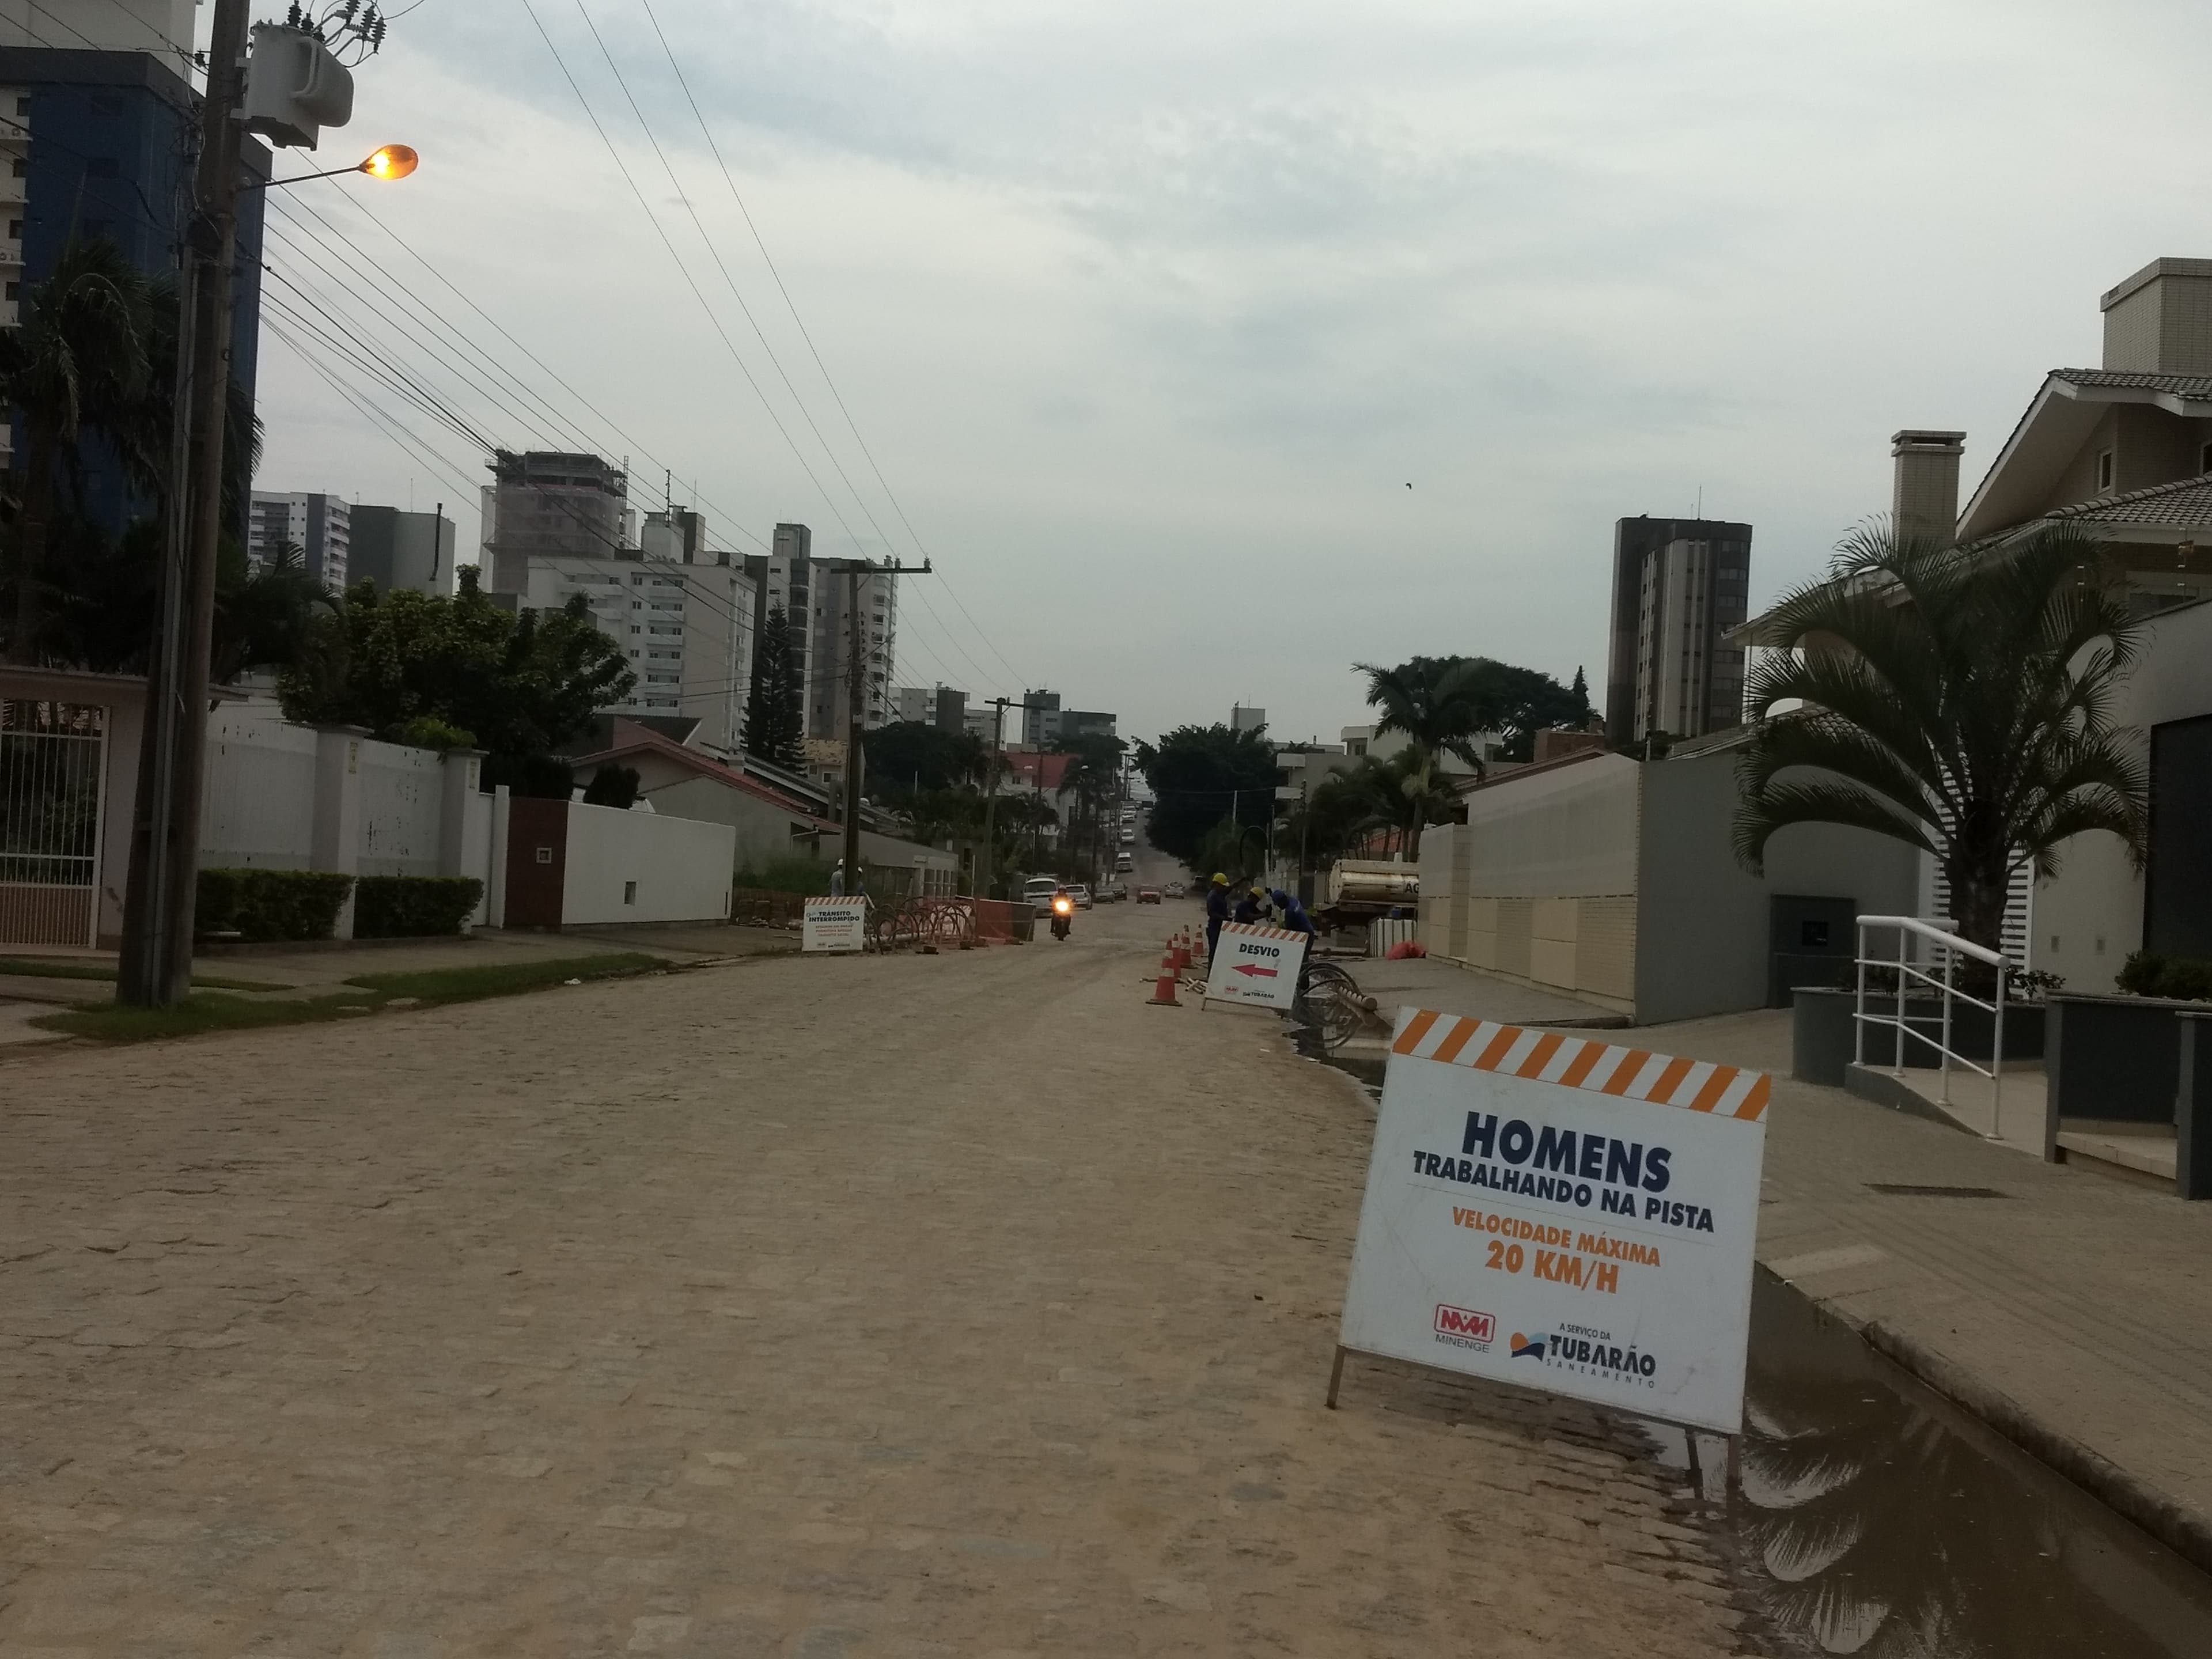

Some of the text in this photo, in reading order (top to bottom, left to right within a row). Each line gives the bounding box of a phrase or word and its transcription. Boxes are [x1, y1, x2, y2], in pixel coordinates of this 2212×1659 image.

[1239, 943, 1279, 957] DESVIO
[1462, 1111, 1672, 1192] HOMENS
[1414, 1150, 1714, 1233] TRABALHANDO NA PISTA
[1453, 1207, 1660, 1267] VELOCIDADE MÁXIMA
[1486, 1240, 1619, 1294] 20 KM/H
[1435, 1335, 1490, 1353] MINENGE
[1559, 1323, 1611, 1340] A SERVIÇO DA
[1547, 1358, 1654, 1388] SANEAMENTO
[1550, 1335, 1656, 1376] TUBARÃO
